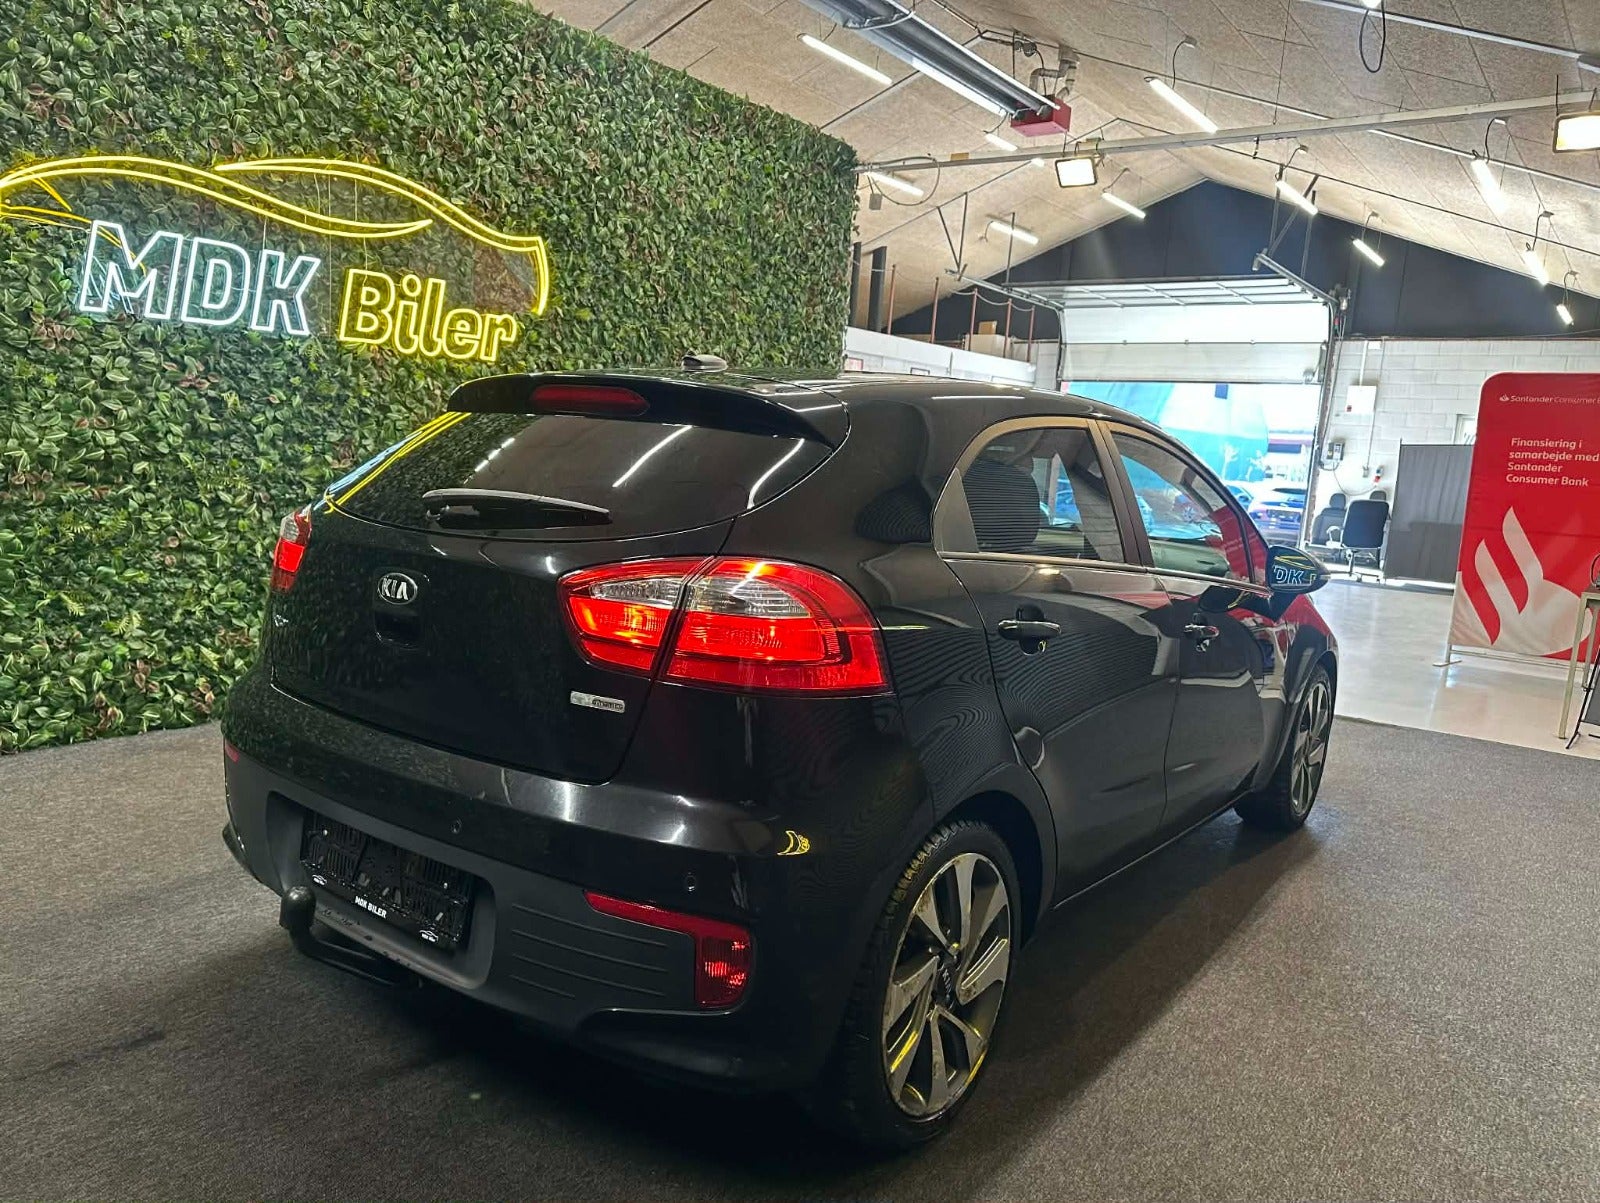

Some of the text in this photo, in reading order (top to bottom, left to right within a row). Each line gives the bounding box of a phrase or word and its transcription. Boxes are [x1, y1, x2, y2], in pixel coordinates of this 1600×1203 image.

[79, 219, 518, 362] MDK Biler
[1510, 394, 1553, 403] Santander
[1554, 396, 1595, 405] Consumer
[1511, 437, 1583, 450] Finansiering i
[1509, 450, 1600, 462] samarbejde med
[1507, 461, 1563, 473] Santander
[1506, 473, 1589, 487] Consumer Bank
[381, 577, 408, 600] KIA
[367, 902, 387, 919] BILER
